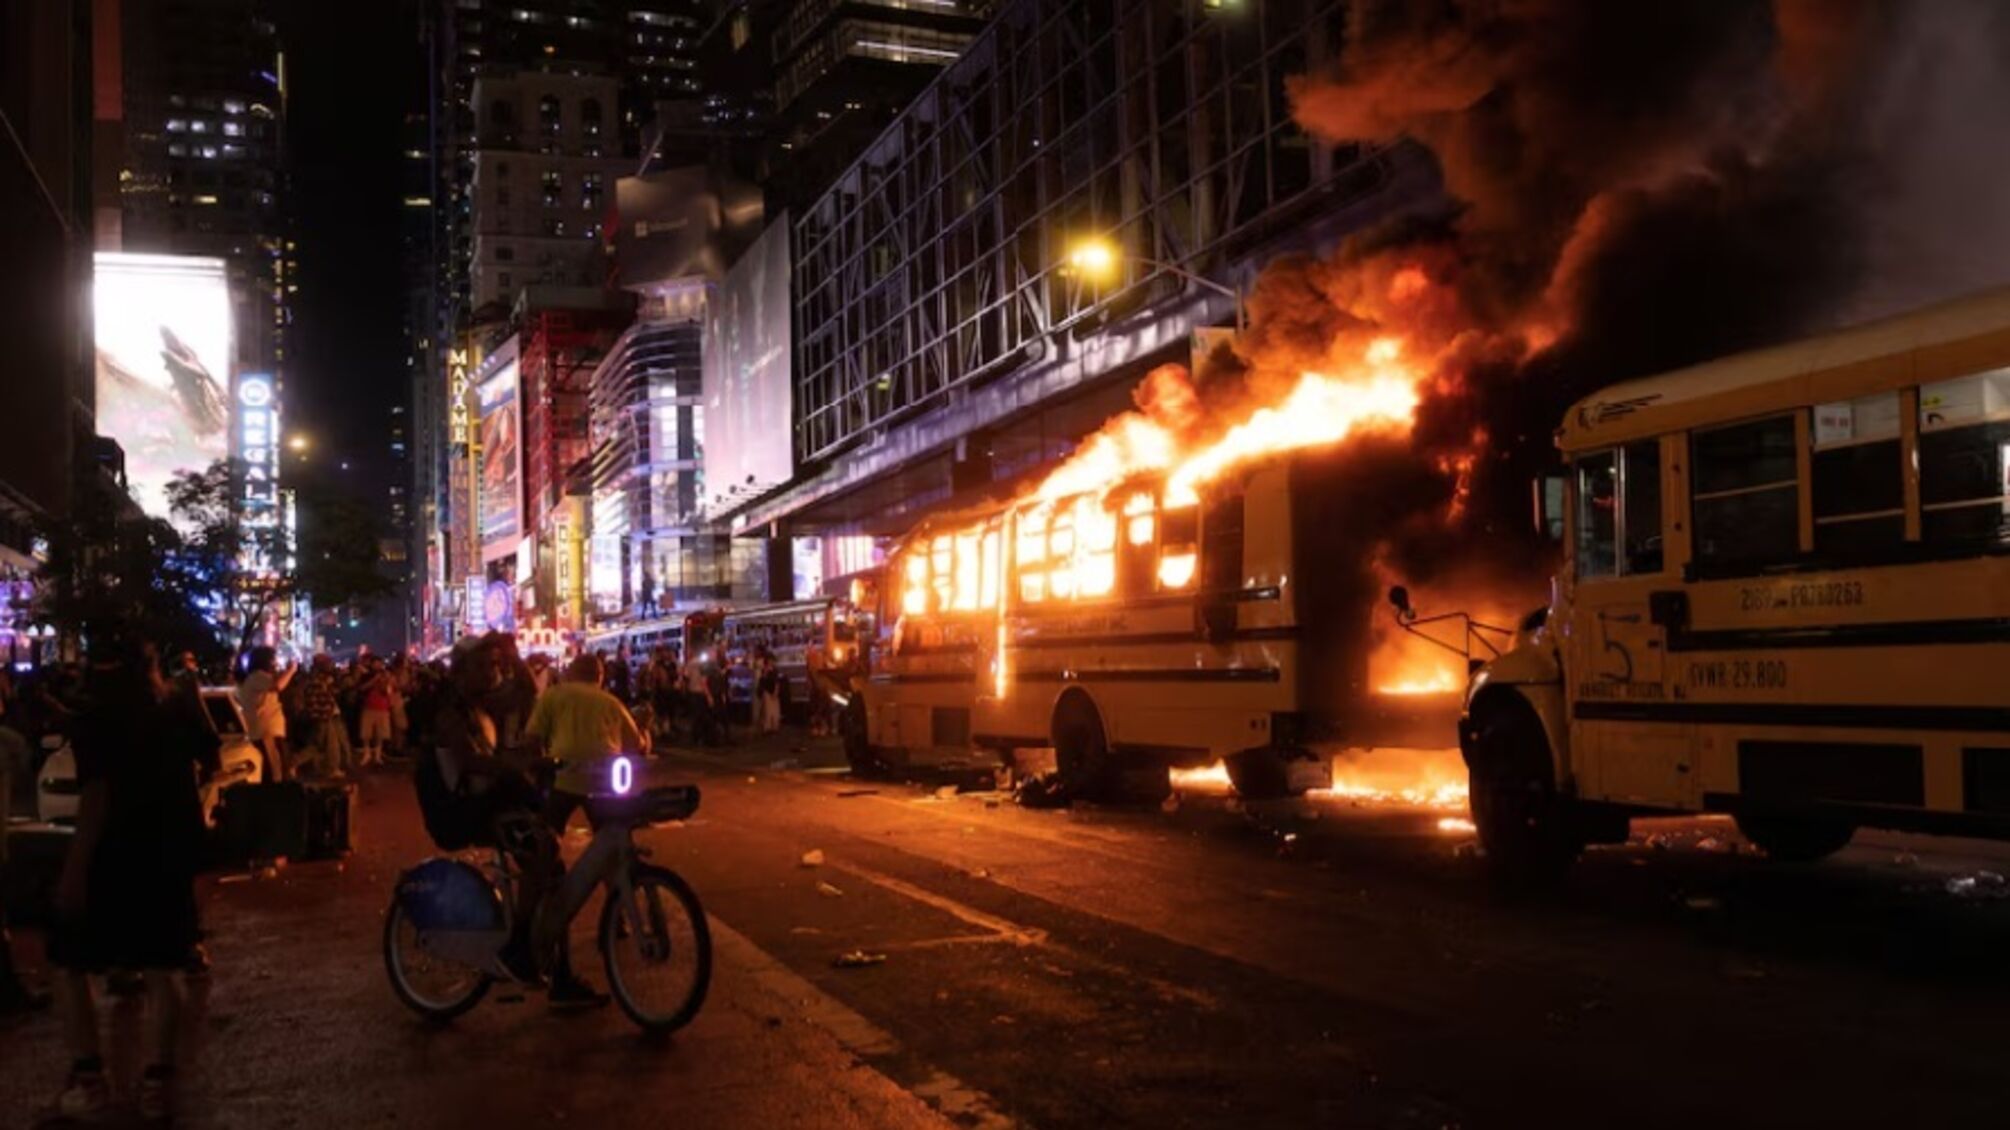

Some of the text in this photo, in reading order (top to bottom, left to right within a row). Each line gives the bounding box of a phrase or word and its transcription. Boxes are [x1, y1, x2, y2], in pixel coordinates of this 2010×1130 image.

[450, 349, 468, 443] MADAME
[244, 410, 267, 499] REGAL
[516, 628, 571, 648] amc
[611, 755, 632, 796] 0
